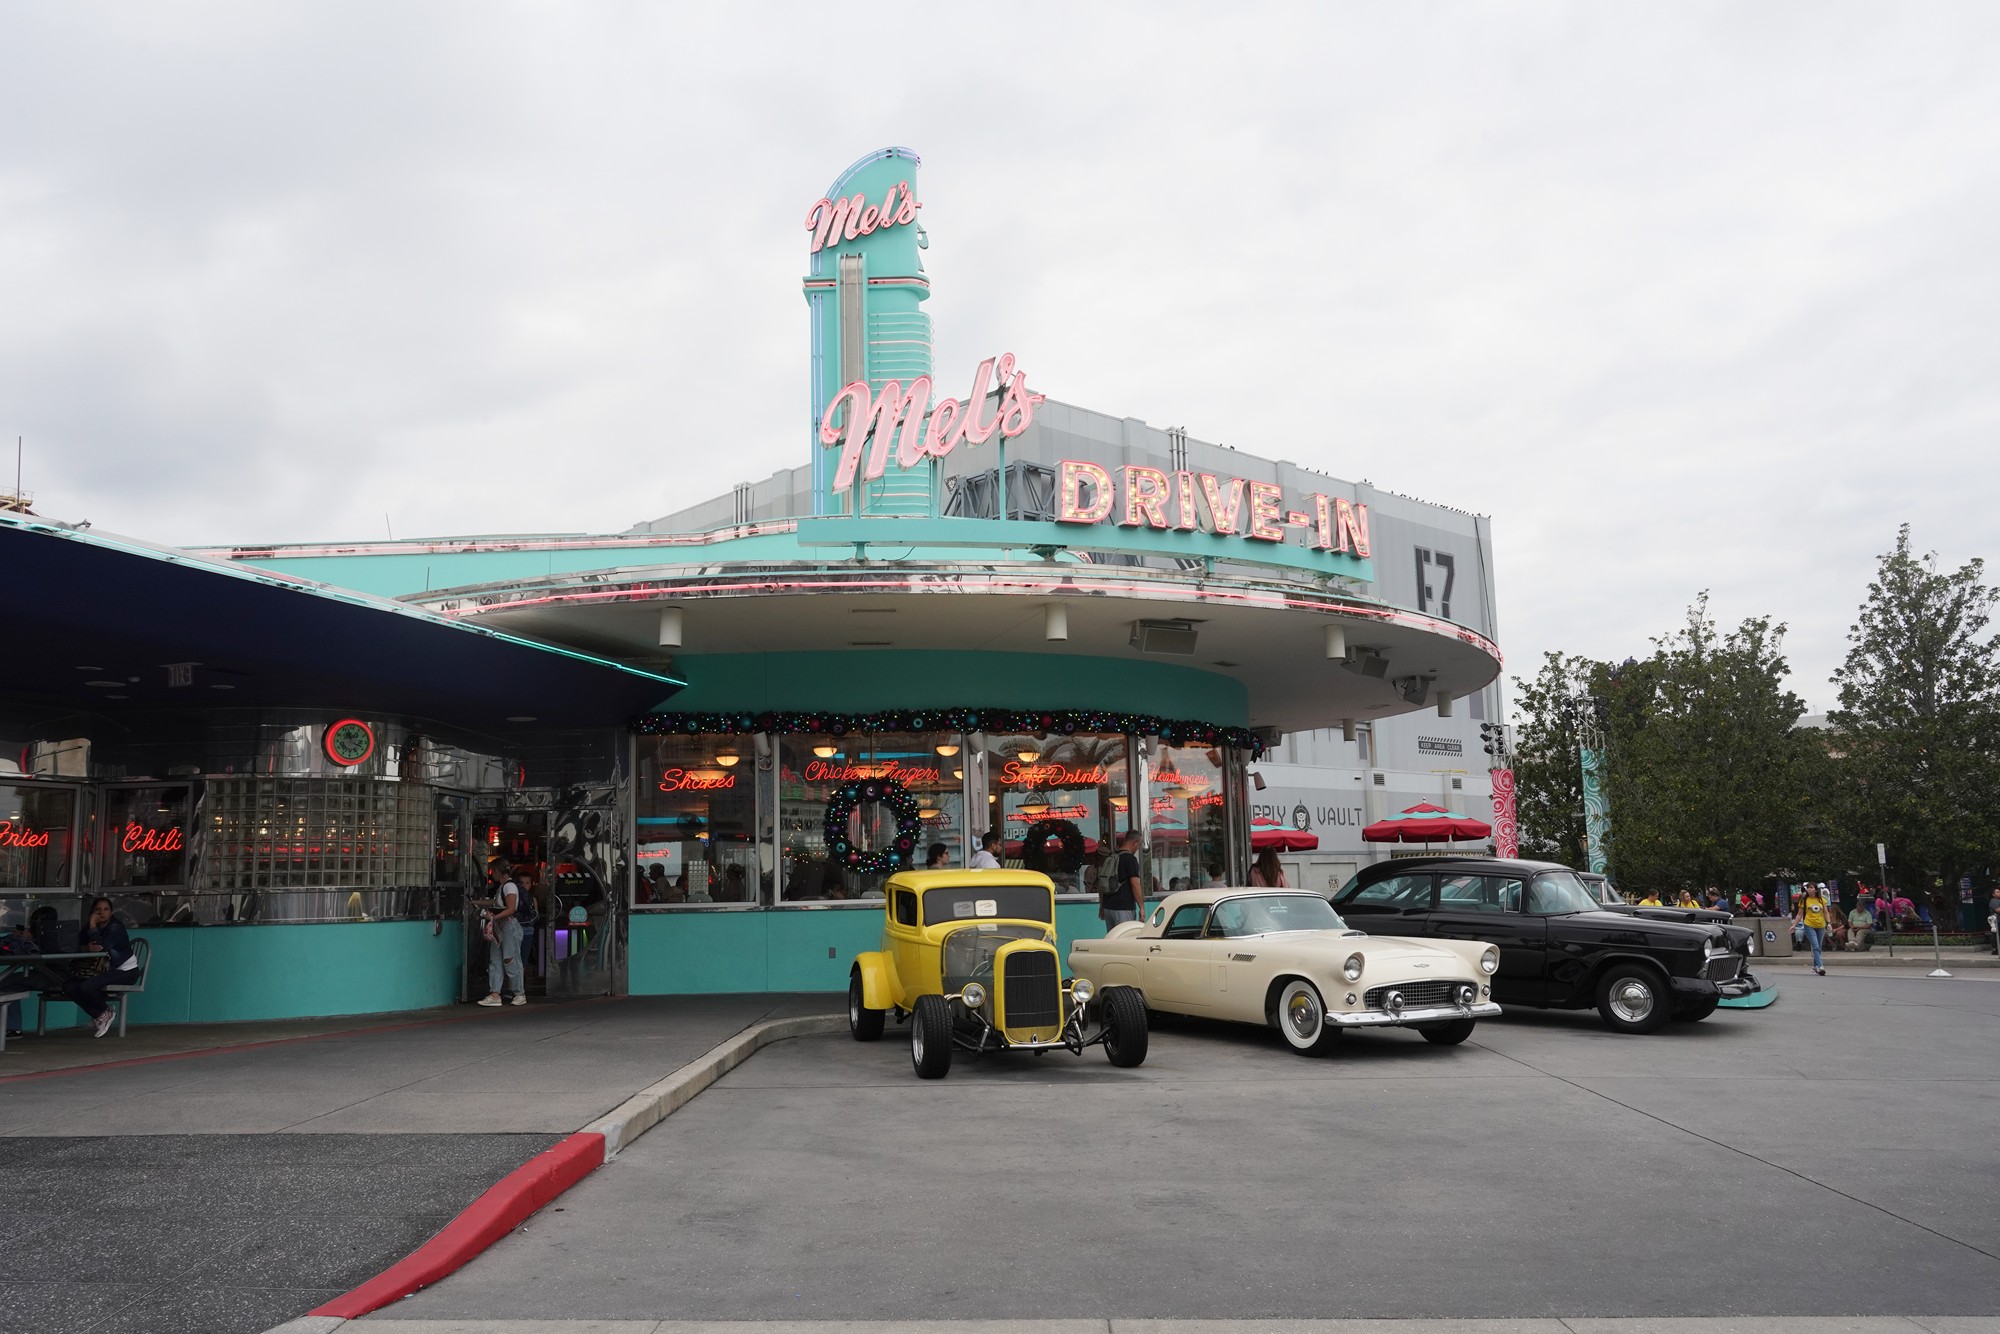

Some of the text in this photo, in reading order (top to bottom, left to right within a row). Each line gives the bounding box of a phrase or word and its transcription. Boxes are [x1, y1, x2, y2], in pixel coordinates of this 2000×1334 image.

[805, 180, 922, 255] Mel's
[819, 352, 1046, 495] Mel's
[1059, 459, 1371, 559] DRIVE-IN
[659, 768, 735, 792] Shakes
[805, 760, 939, 788] Chicken Fingers
[1000, 761, 1109, 789] Soft Drinks
[1147, 761, 1209, 788] Hamburgers
[1317, 806, 1362, 826] VAULT
[122, 825, 184, 853] Chili
